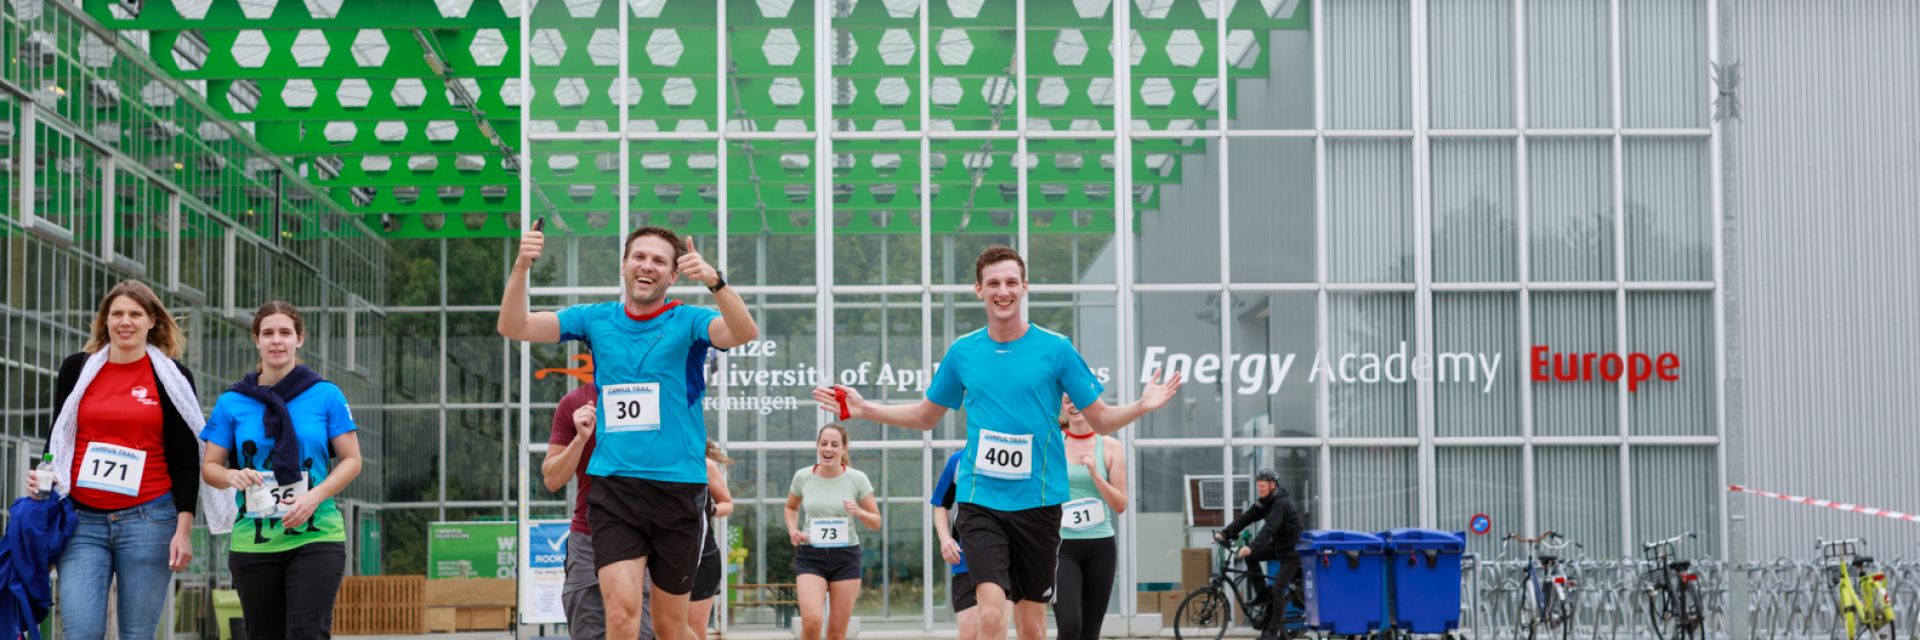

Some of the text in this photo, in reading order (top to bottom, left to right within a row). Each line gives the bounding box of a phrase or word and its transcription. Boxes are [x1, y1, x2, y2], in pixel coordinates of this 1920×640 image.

[840, 361, 872, 386] of
[1140, 340, 1681, 395] Energy Academy Europe
[617, 400, 641, 420] 30
[703, 391, 798, 415] roningen
[984, 447, 1024, 468] 400
[92, 459, 129, 481] 171
[1072, 509, 1091, 525] 31
[820, 527, 838, 540] 73
